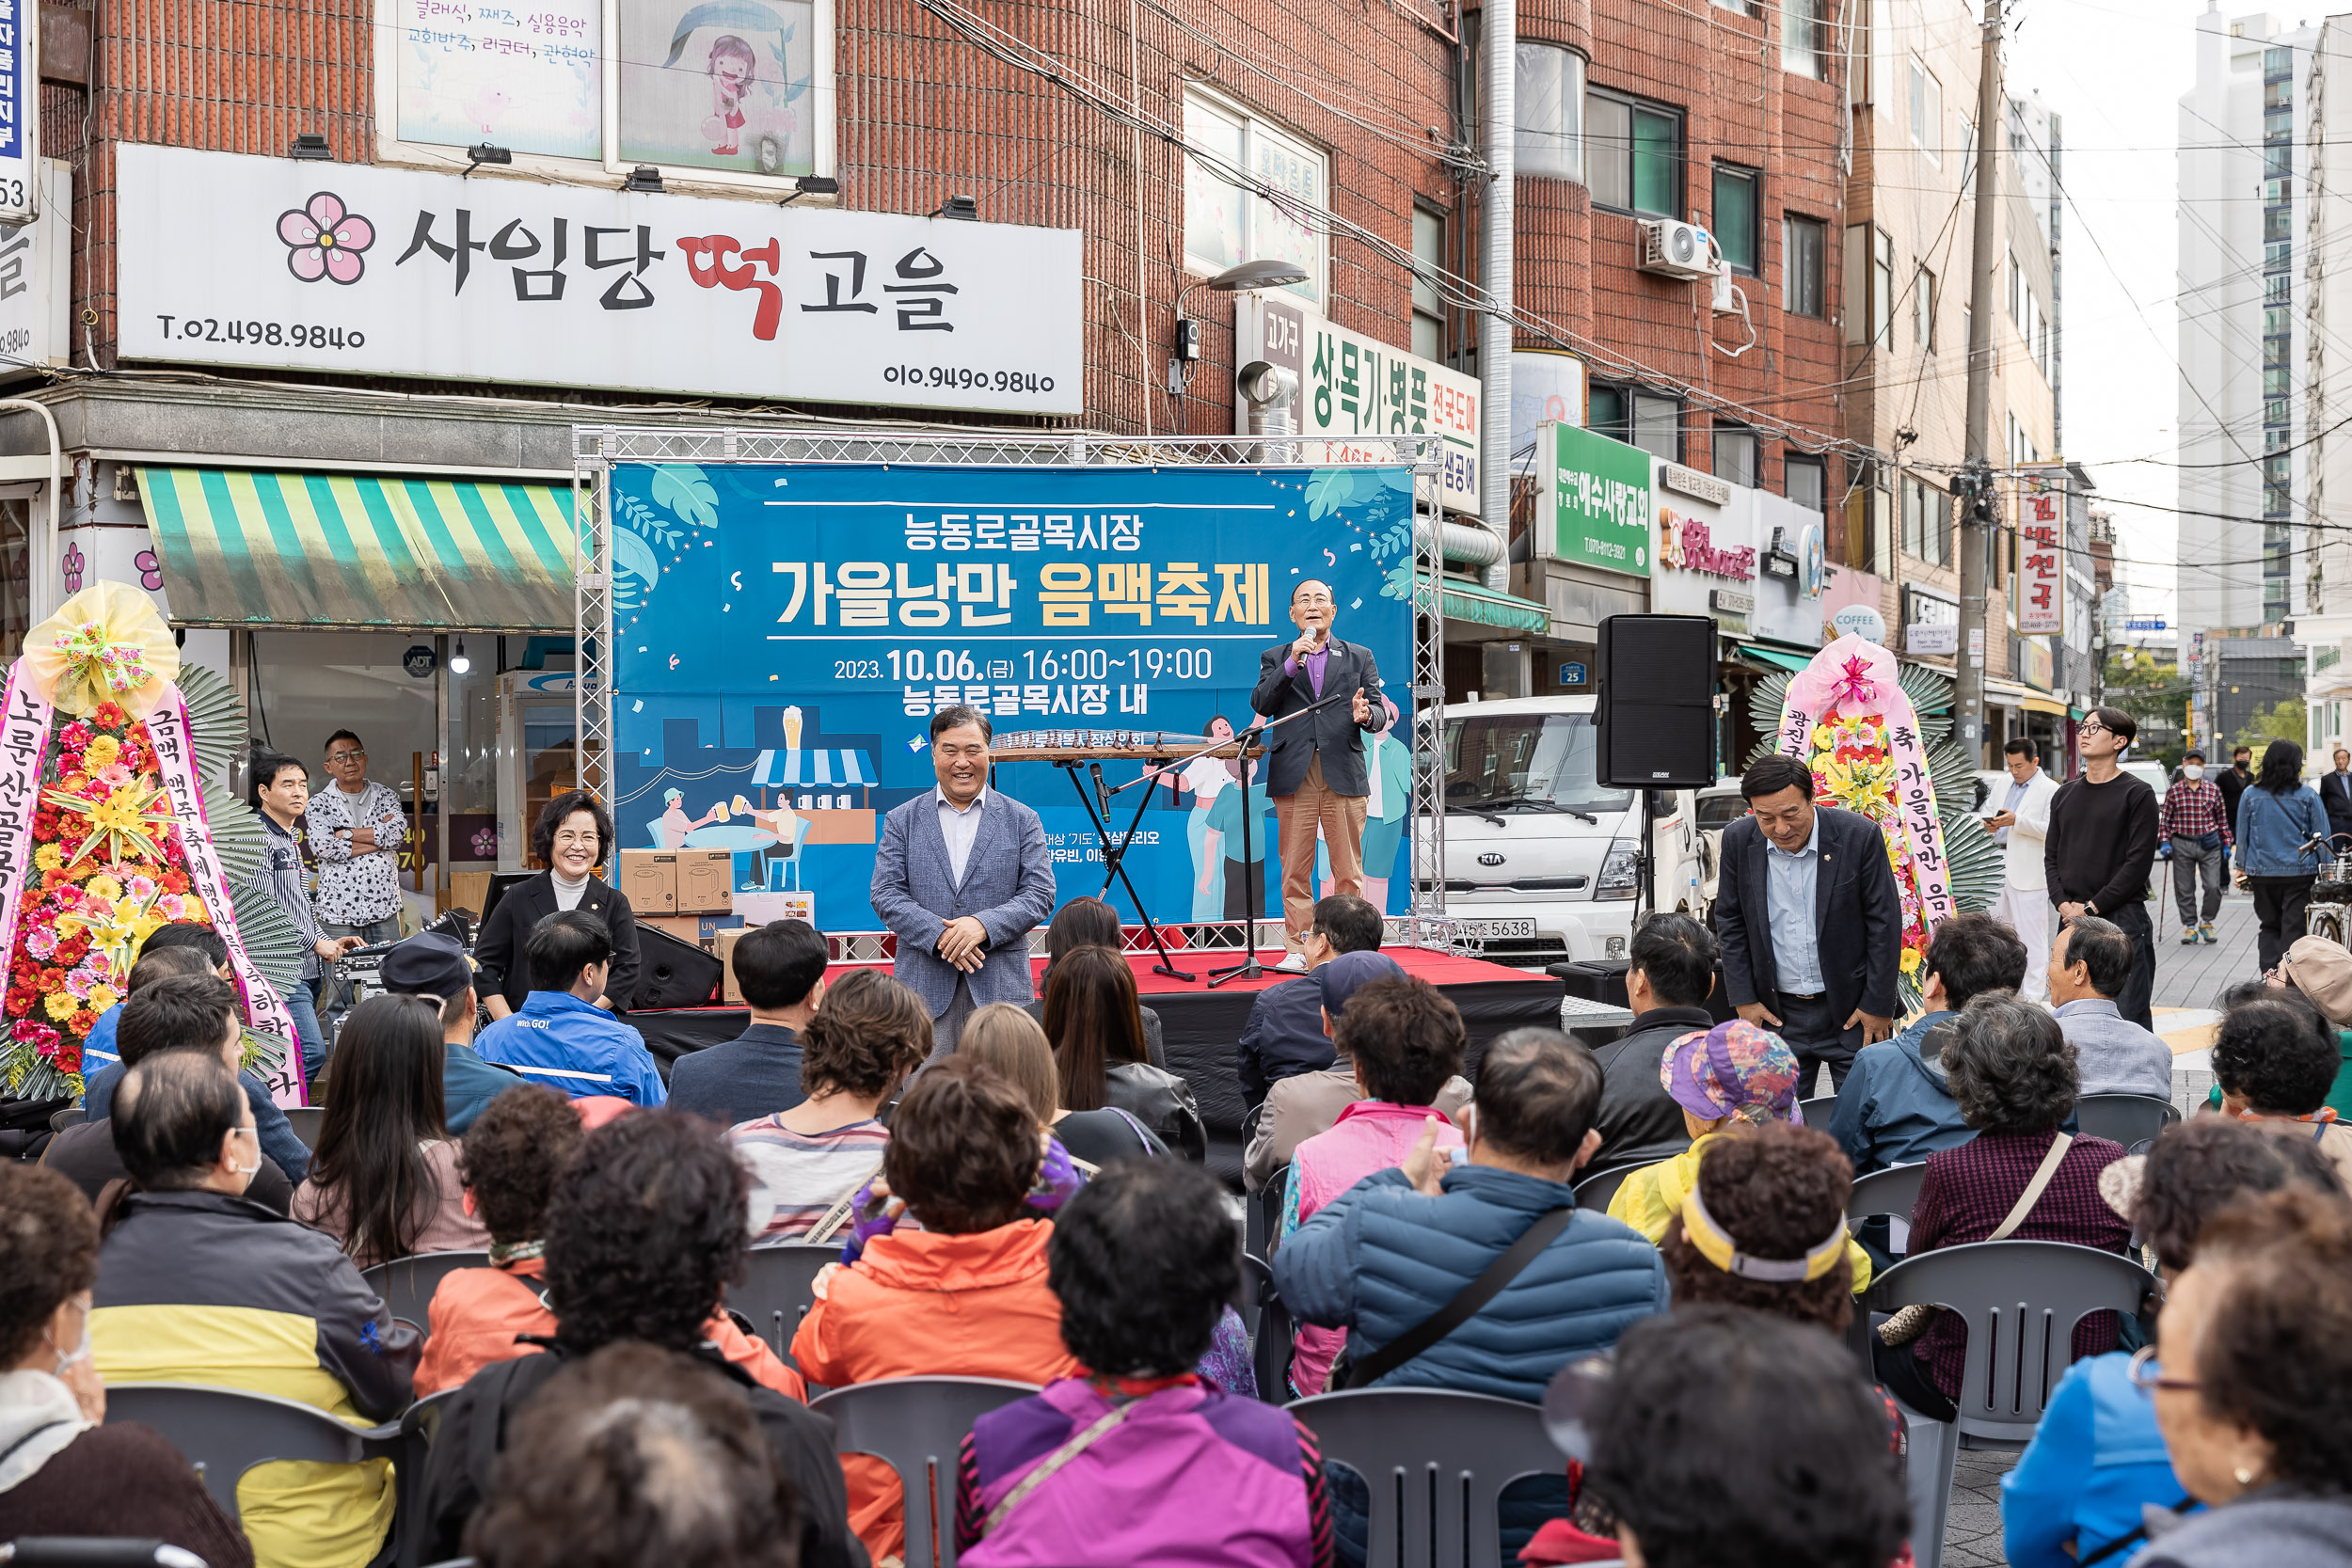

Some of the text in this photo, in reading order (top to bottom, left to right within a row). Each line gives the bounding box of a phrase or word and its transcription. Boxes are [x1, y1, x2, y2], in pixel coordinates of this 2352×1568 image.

[528, 13, 587, 38] 실용음악
[543, 44, 596, 68] 관현악
[156, 314, 366, 349] T.02.498.9840
[1267, 312, 1298, 357] 고가구
[883, 365, 1055, 393] 010.9490.9840
[1433, 383, 1476, 436] 전국도매
[904, 513, 1144, 552] 능동로골목시장
[2025, 495, 2058, 610] 김밥천국
[771, 562, 1271, 627] 가을낭만 음맥축제
[1836, 614, 1874, 625] COFFEE
[408, 657, 432, 668] ADT
[834, 660, 883, 679] 2023.
[1023, 648, 1213, 680] 16:00~19:00
[564, 679, 597, 690] Aua
[1566, 673, 1580, 682] 25
[902, 684, 1148, 716] 능동로골목시장 내
[1892, 726, 1915, 752] 축
[1900, 762, 1941, 871] 가을낭만
[1480, 854, 1502, 864] KIA
[1491, 922, 1530, 937] 5638
[531, 1019, 550, 1030] GO!
